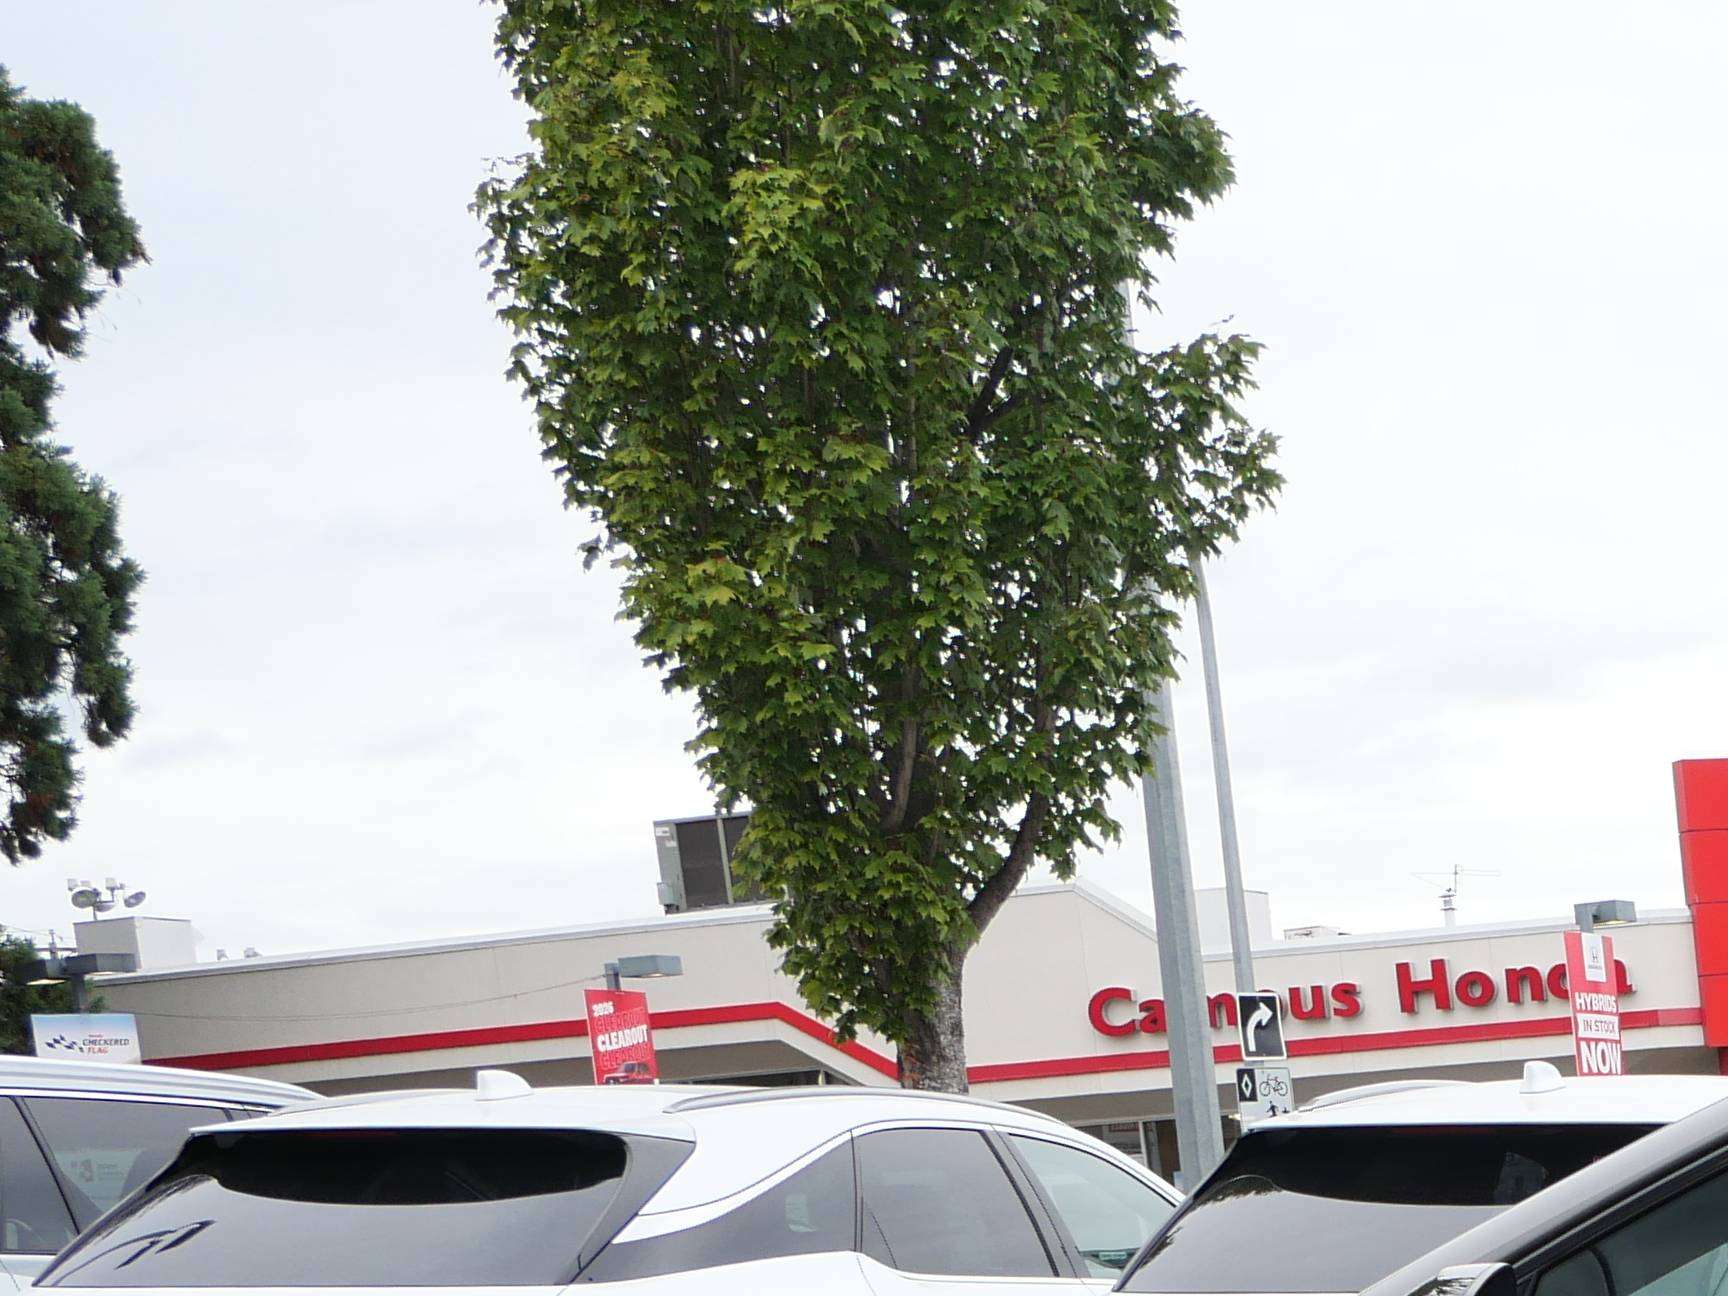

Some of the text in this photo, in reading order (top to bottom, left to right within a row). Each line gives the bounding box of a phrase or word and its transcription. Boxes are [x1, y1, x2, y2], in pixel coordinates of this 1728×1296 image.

[1088, 982, 1362, 1037] Camus
[1575, 991, 1617, 1013] HYBRIDS
[597, 1024, 648, 1052] CLEAROUT
[1583, 1019, 1616, 1034] IN STOCK
[82, 1038, 130, 1047] CHECKERED
[1580, 1040, 1621, 1075] NOW
